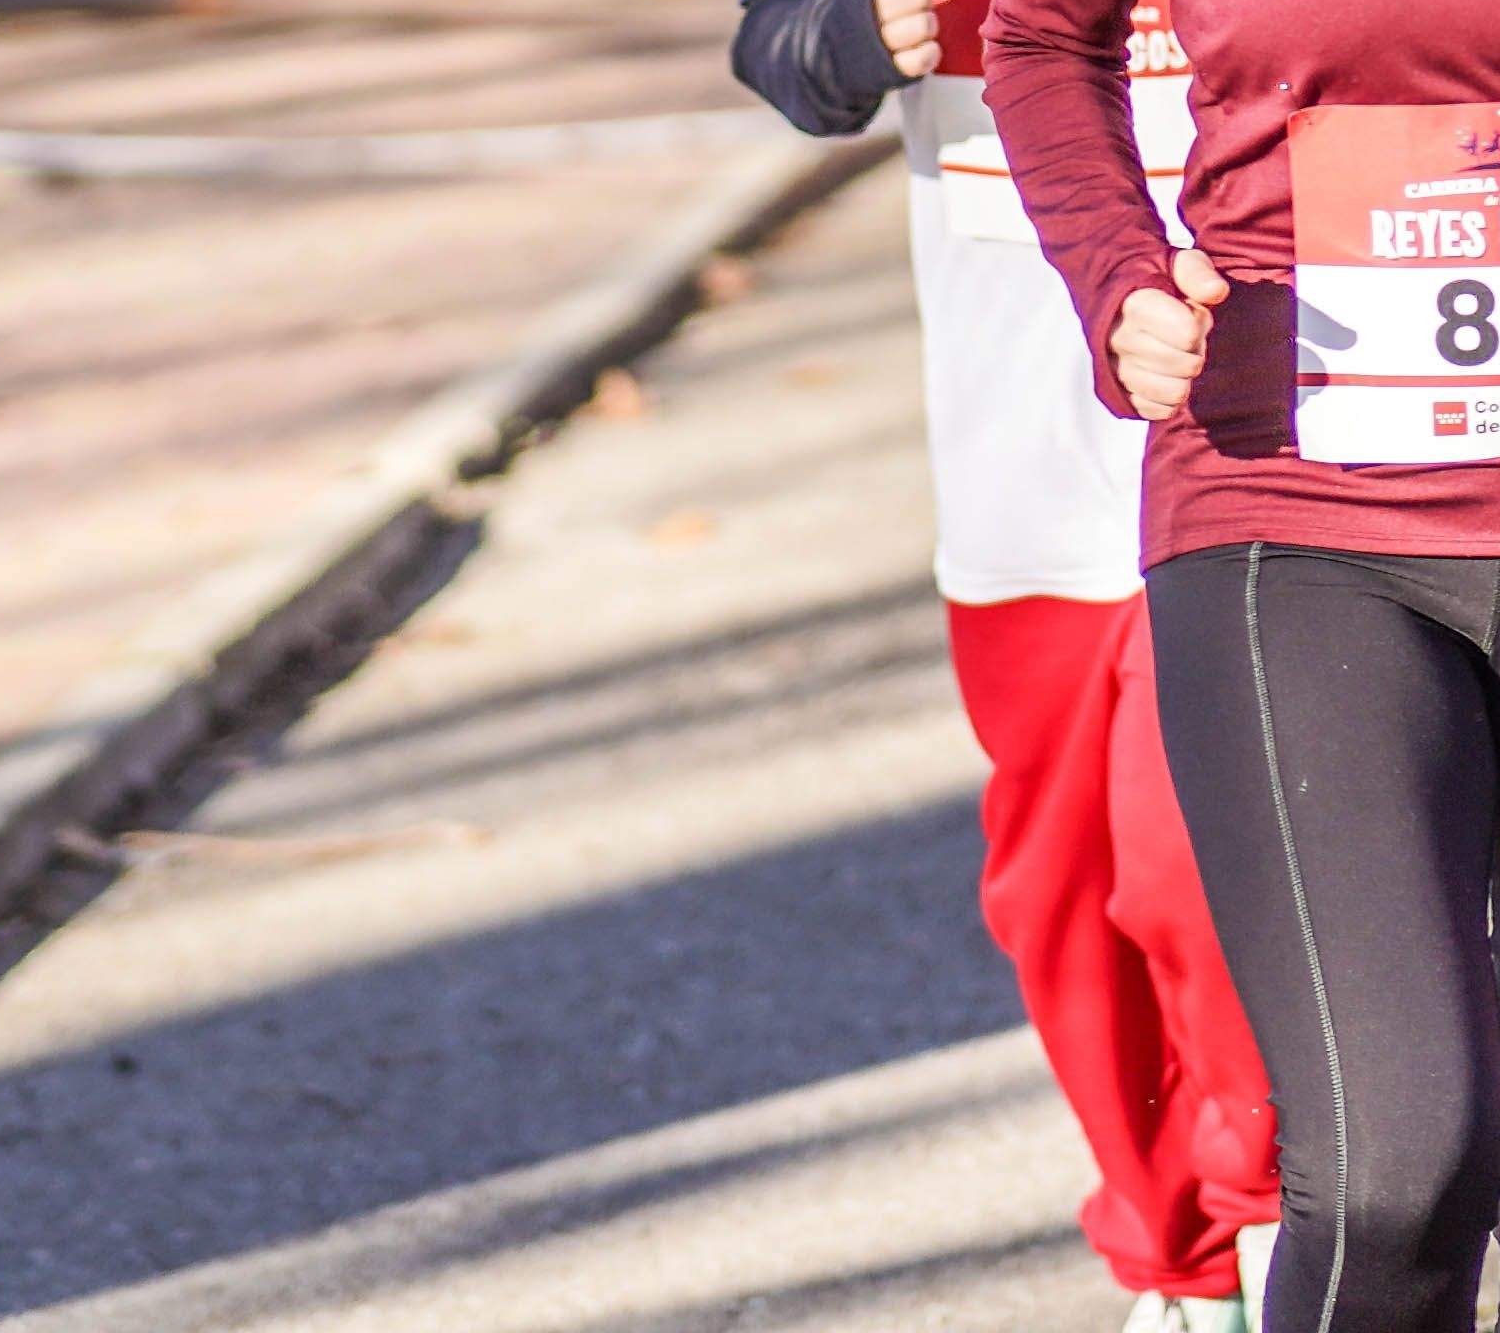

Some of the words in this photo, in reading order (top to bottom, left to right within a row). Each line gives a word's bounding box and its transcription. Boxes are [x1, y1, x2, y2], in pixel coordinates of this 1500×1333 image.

[1404, 177, 1499, 198] CARRERA
[1371, 209, 1487, 259] REYES
[1476, 420, 1500, 434] de
